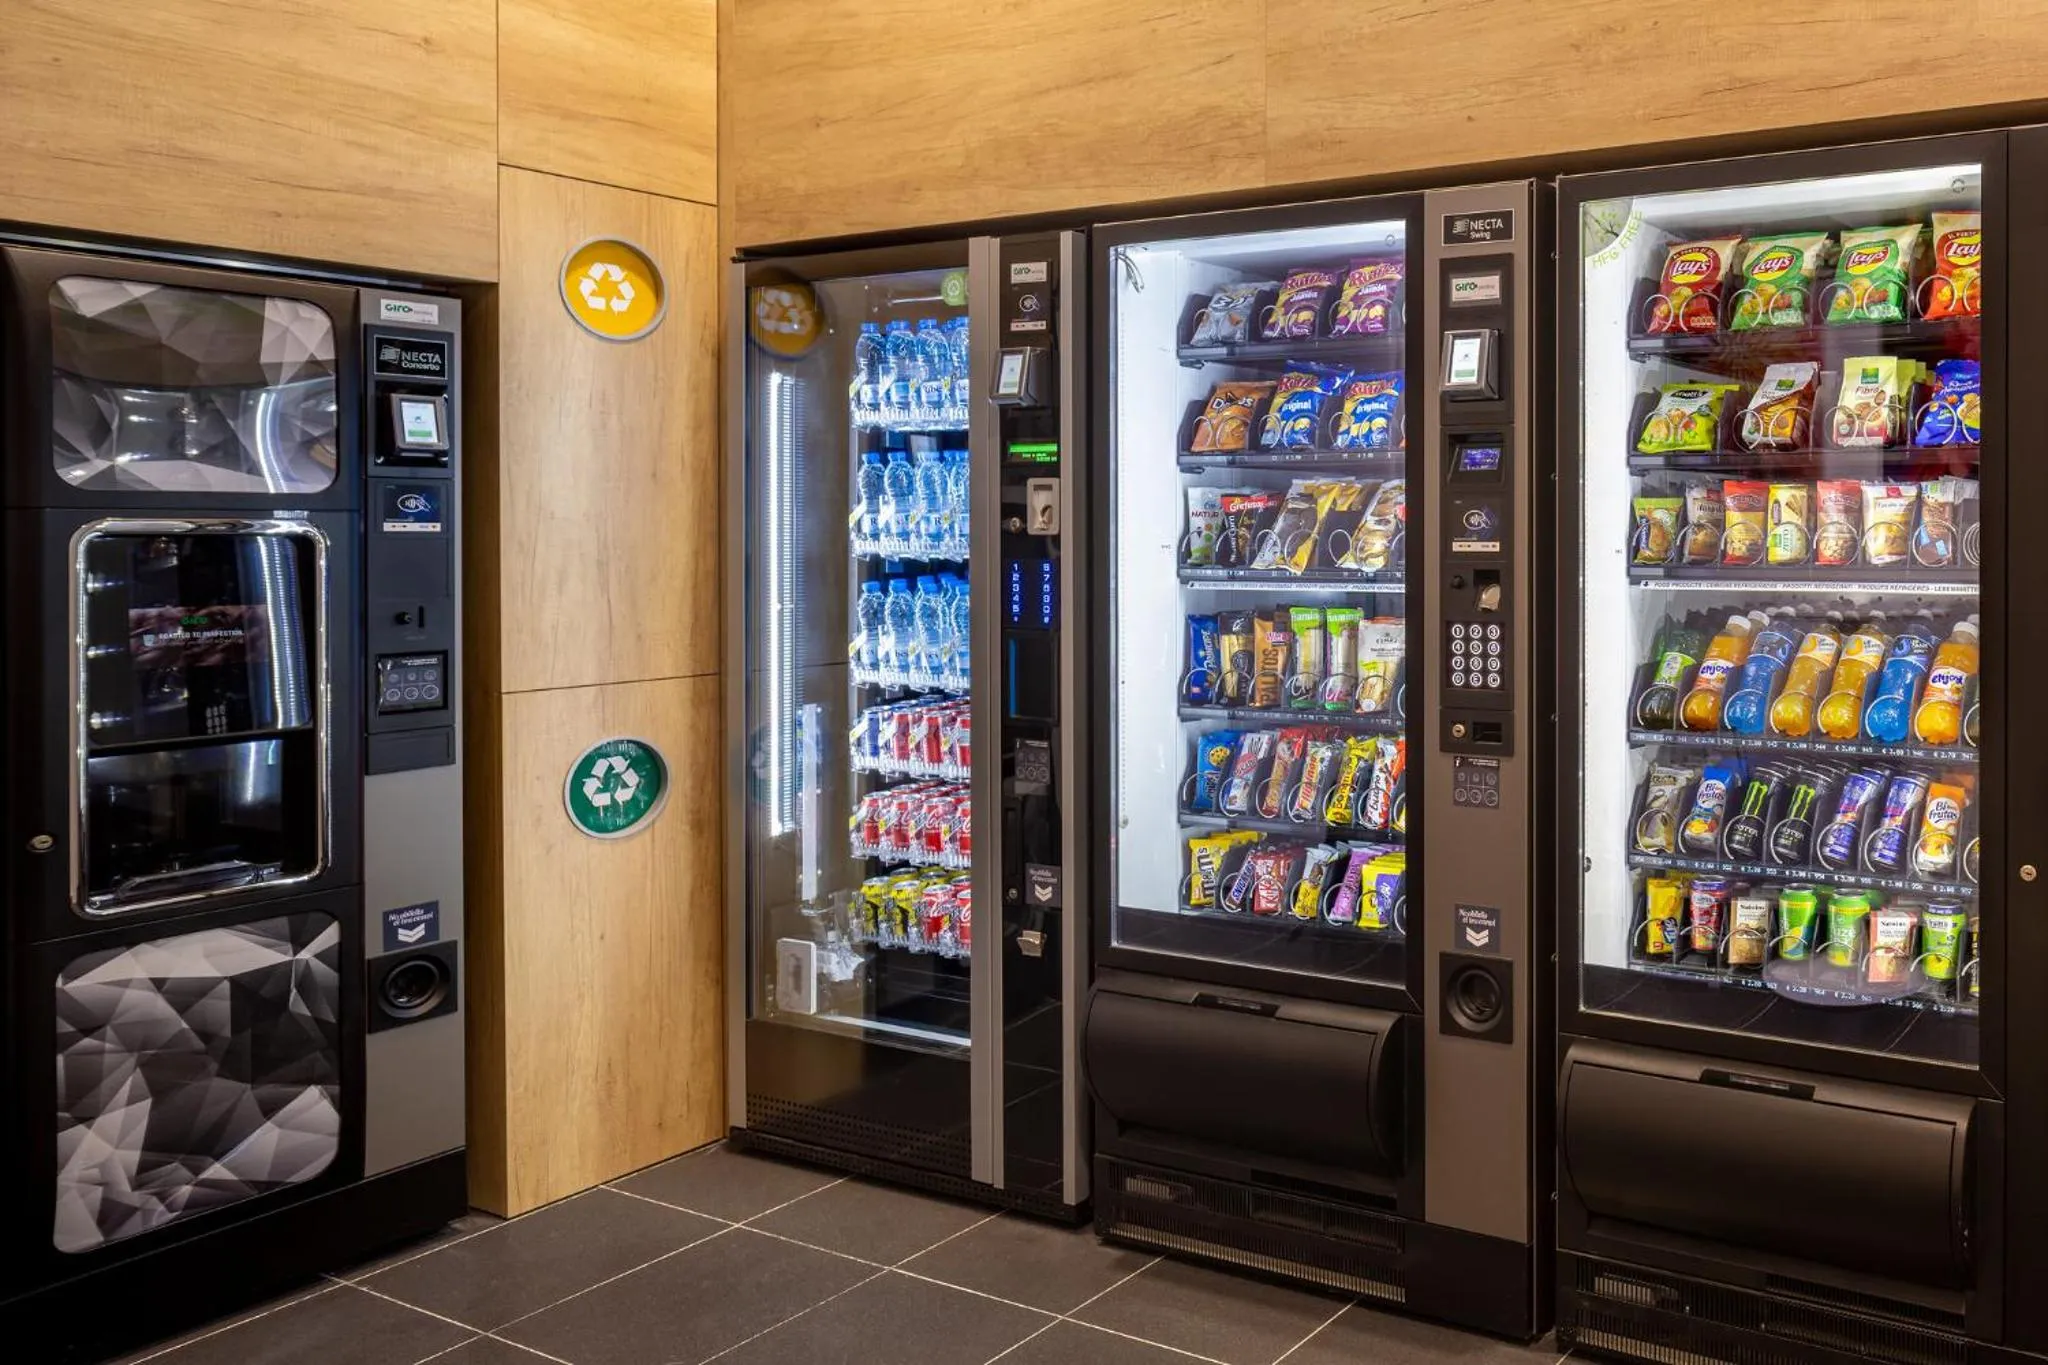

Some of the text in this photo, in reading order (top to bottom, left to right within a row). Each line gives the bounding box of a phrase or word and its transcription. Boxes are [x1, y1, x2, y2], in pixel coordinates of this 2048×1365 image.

[1470, 218, 1504, 230] NECTA
[1470, 231, 1491, 240] Swing
[1283, 272, 1336, 290] Ruffles
[1350, 263, 1403, 288] Ruffles
[401, 351, 442, 364] NECTA
